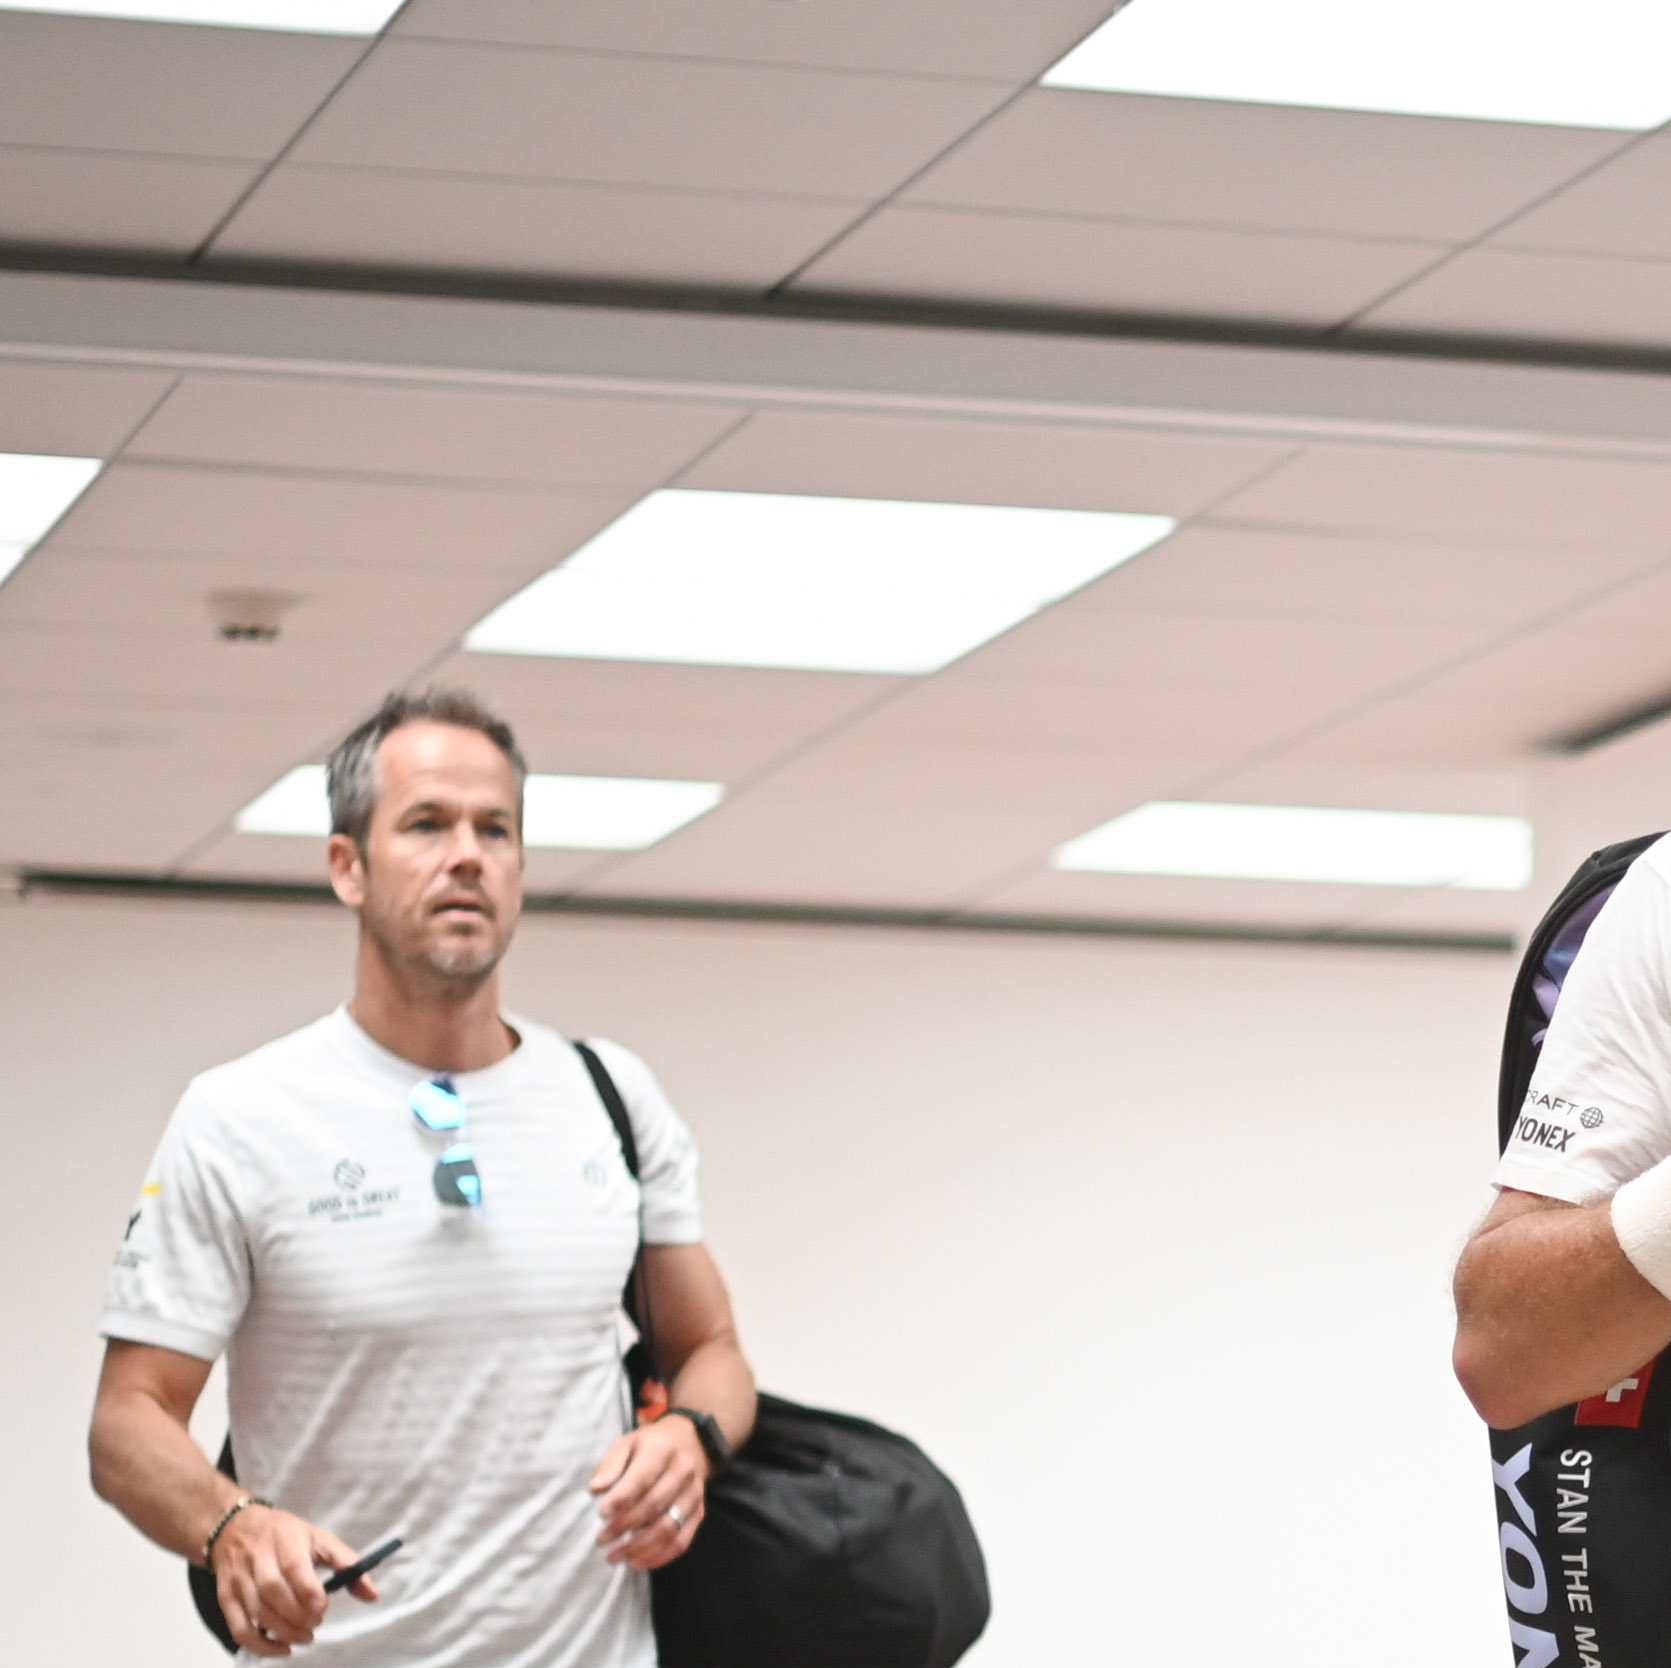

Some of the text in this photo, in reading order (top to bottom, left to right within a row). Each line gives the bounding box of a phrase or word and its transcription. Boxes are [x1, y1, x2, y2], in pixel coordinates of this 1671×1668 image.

[1526, 1089, 1580, 1116] RAFT
[1515, 1116, 1576, 1153] YONEX
[1556, 1449, 1593, 1534] STAN
[1561, 1548, 1593, 1614] THE
